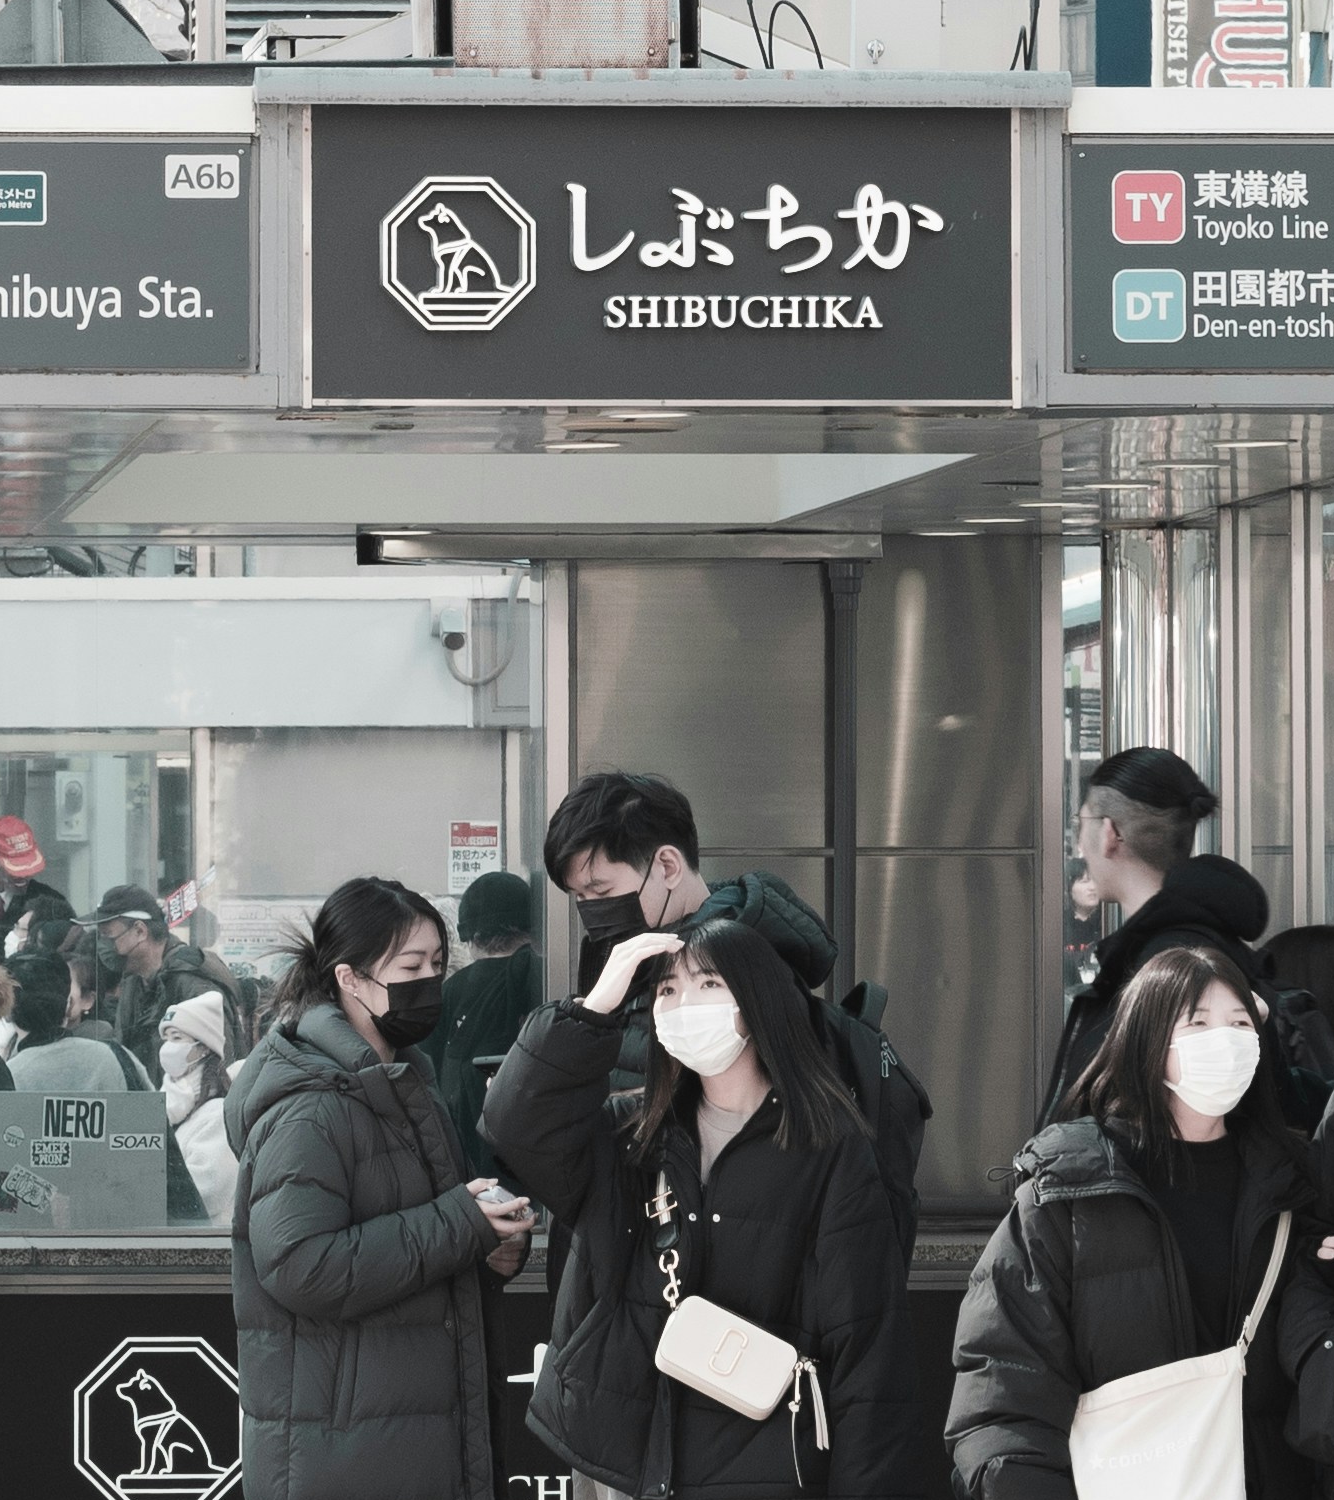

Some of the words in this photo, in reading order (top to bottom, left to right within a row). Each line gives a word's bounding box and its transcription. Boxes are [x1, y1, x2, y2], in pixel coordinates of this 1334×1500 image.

[169, 161, 236, 193] A6b
[1193, 170, 1310, 209] 東横線
[8, 199, 33, 210] Metro
[1124, 191, 1173, 222] TY
[565, 181, 946, 274] しぶちか
[1193, 214, 1275, 245] Toyoko
[1282, 213, 1329, 240] Line
[138, 275, 214, 320] Sta.
[603, 294, 884, 330] SHIBUCHIKA
[1125, 292, 1174, 321] DT
[452, 849, 497, 861] 防犯カメラ
[452, 861, 482, 873] 作動中
[43, 1098, 105, 1139] NERO
[34, 1141, 68, 1154] EMEK
[111, 1135, 163, 1150] SOAR
